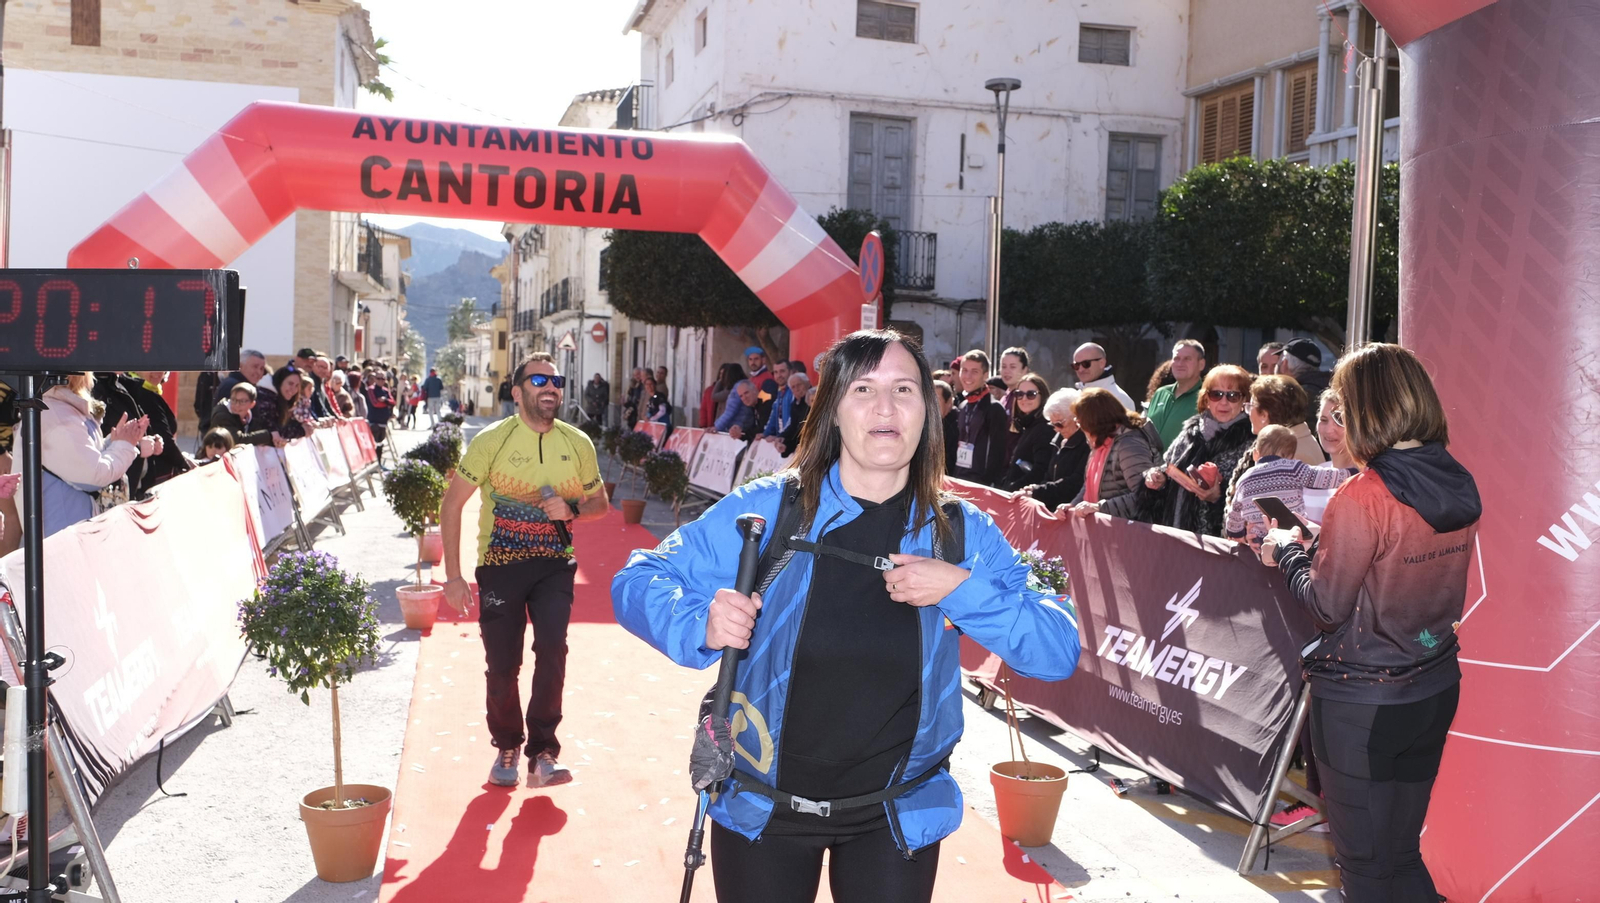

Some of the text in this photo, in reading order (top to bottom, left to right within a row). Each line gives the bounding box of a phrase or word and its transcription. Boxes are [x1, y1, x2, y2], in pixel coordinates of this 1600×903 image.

[352, 116, 654, 160] AYUNTAMIENTO
[360, 155, 642, 216] CANTORIA
[1403, 554, 1427, 564] VALLE
[1428, 551, 1437, 560] DE
[1096, 624, 1248, 701] TEAMERGY
[1108, 684, 1183, 726] www.teamergy.es
